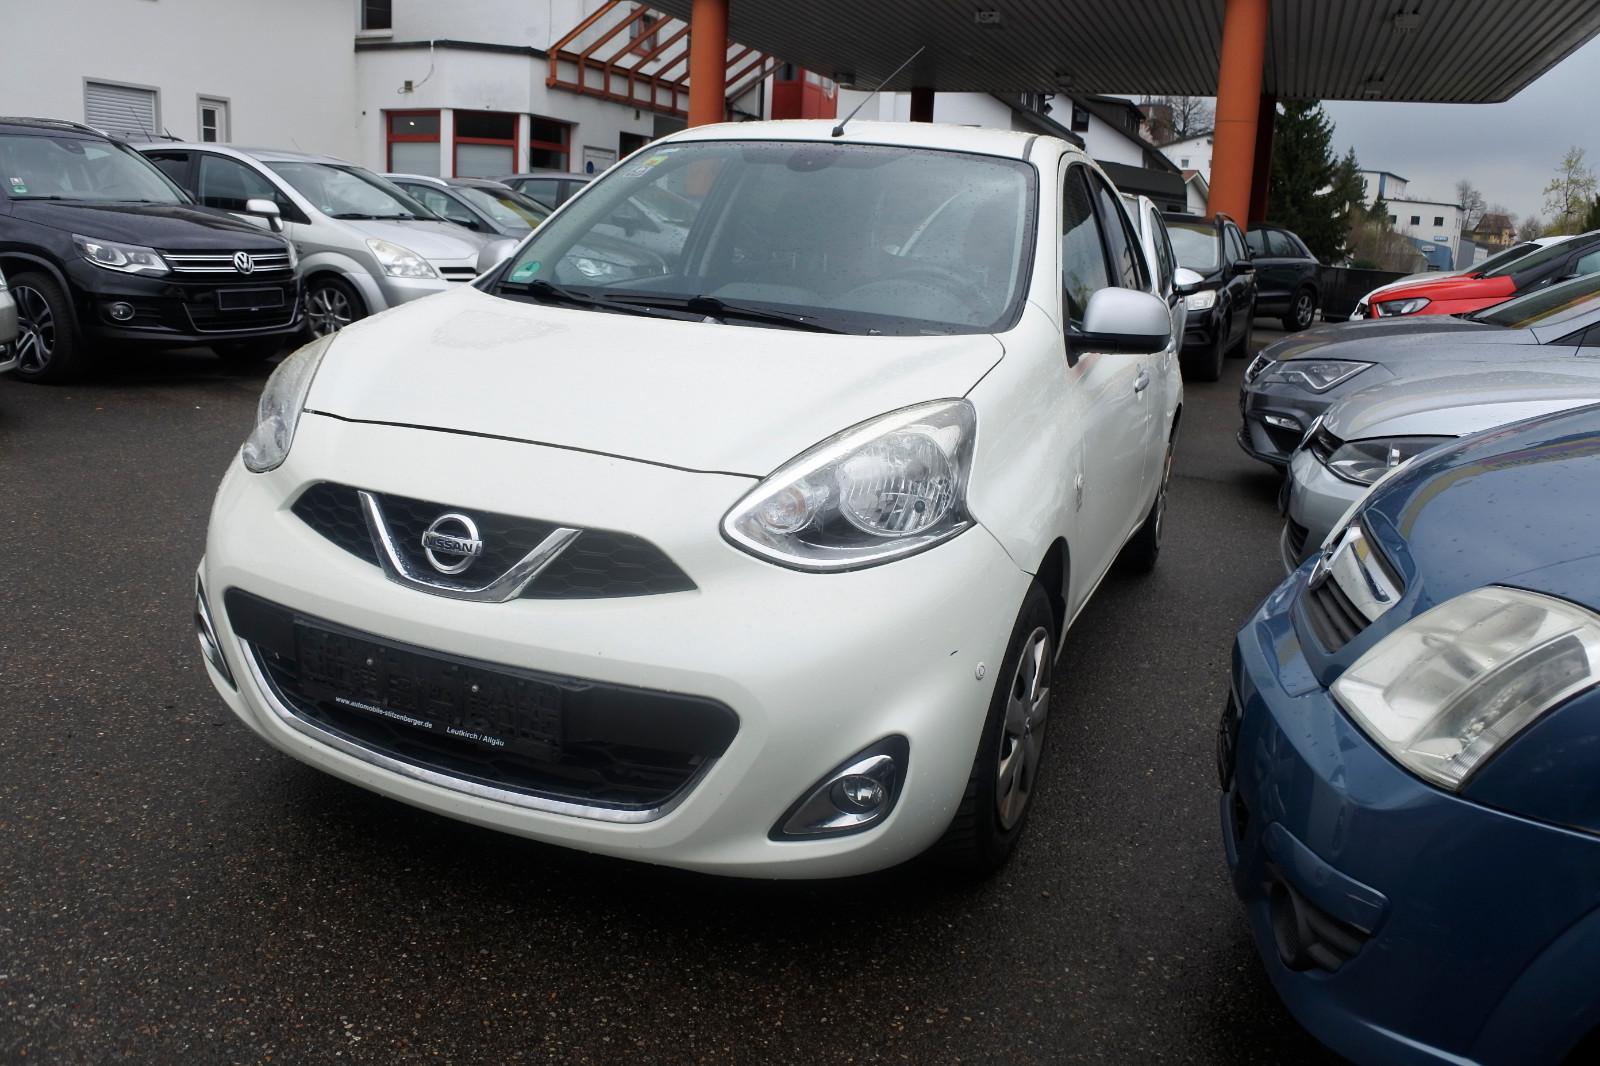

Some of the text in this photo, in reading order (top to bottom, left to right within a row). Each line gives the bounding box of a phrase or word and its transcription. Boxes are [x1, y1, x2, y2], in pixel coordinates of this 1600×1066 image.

[425, 536, 473, 553] NISSAN
[446, 726, 478, 740] Leutkirch
[482, 735, 505, 746] Allgäu
